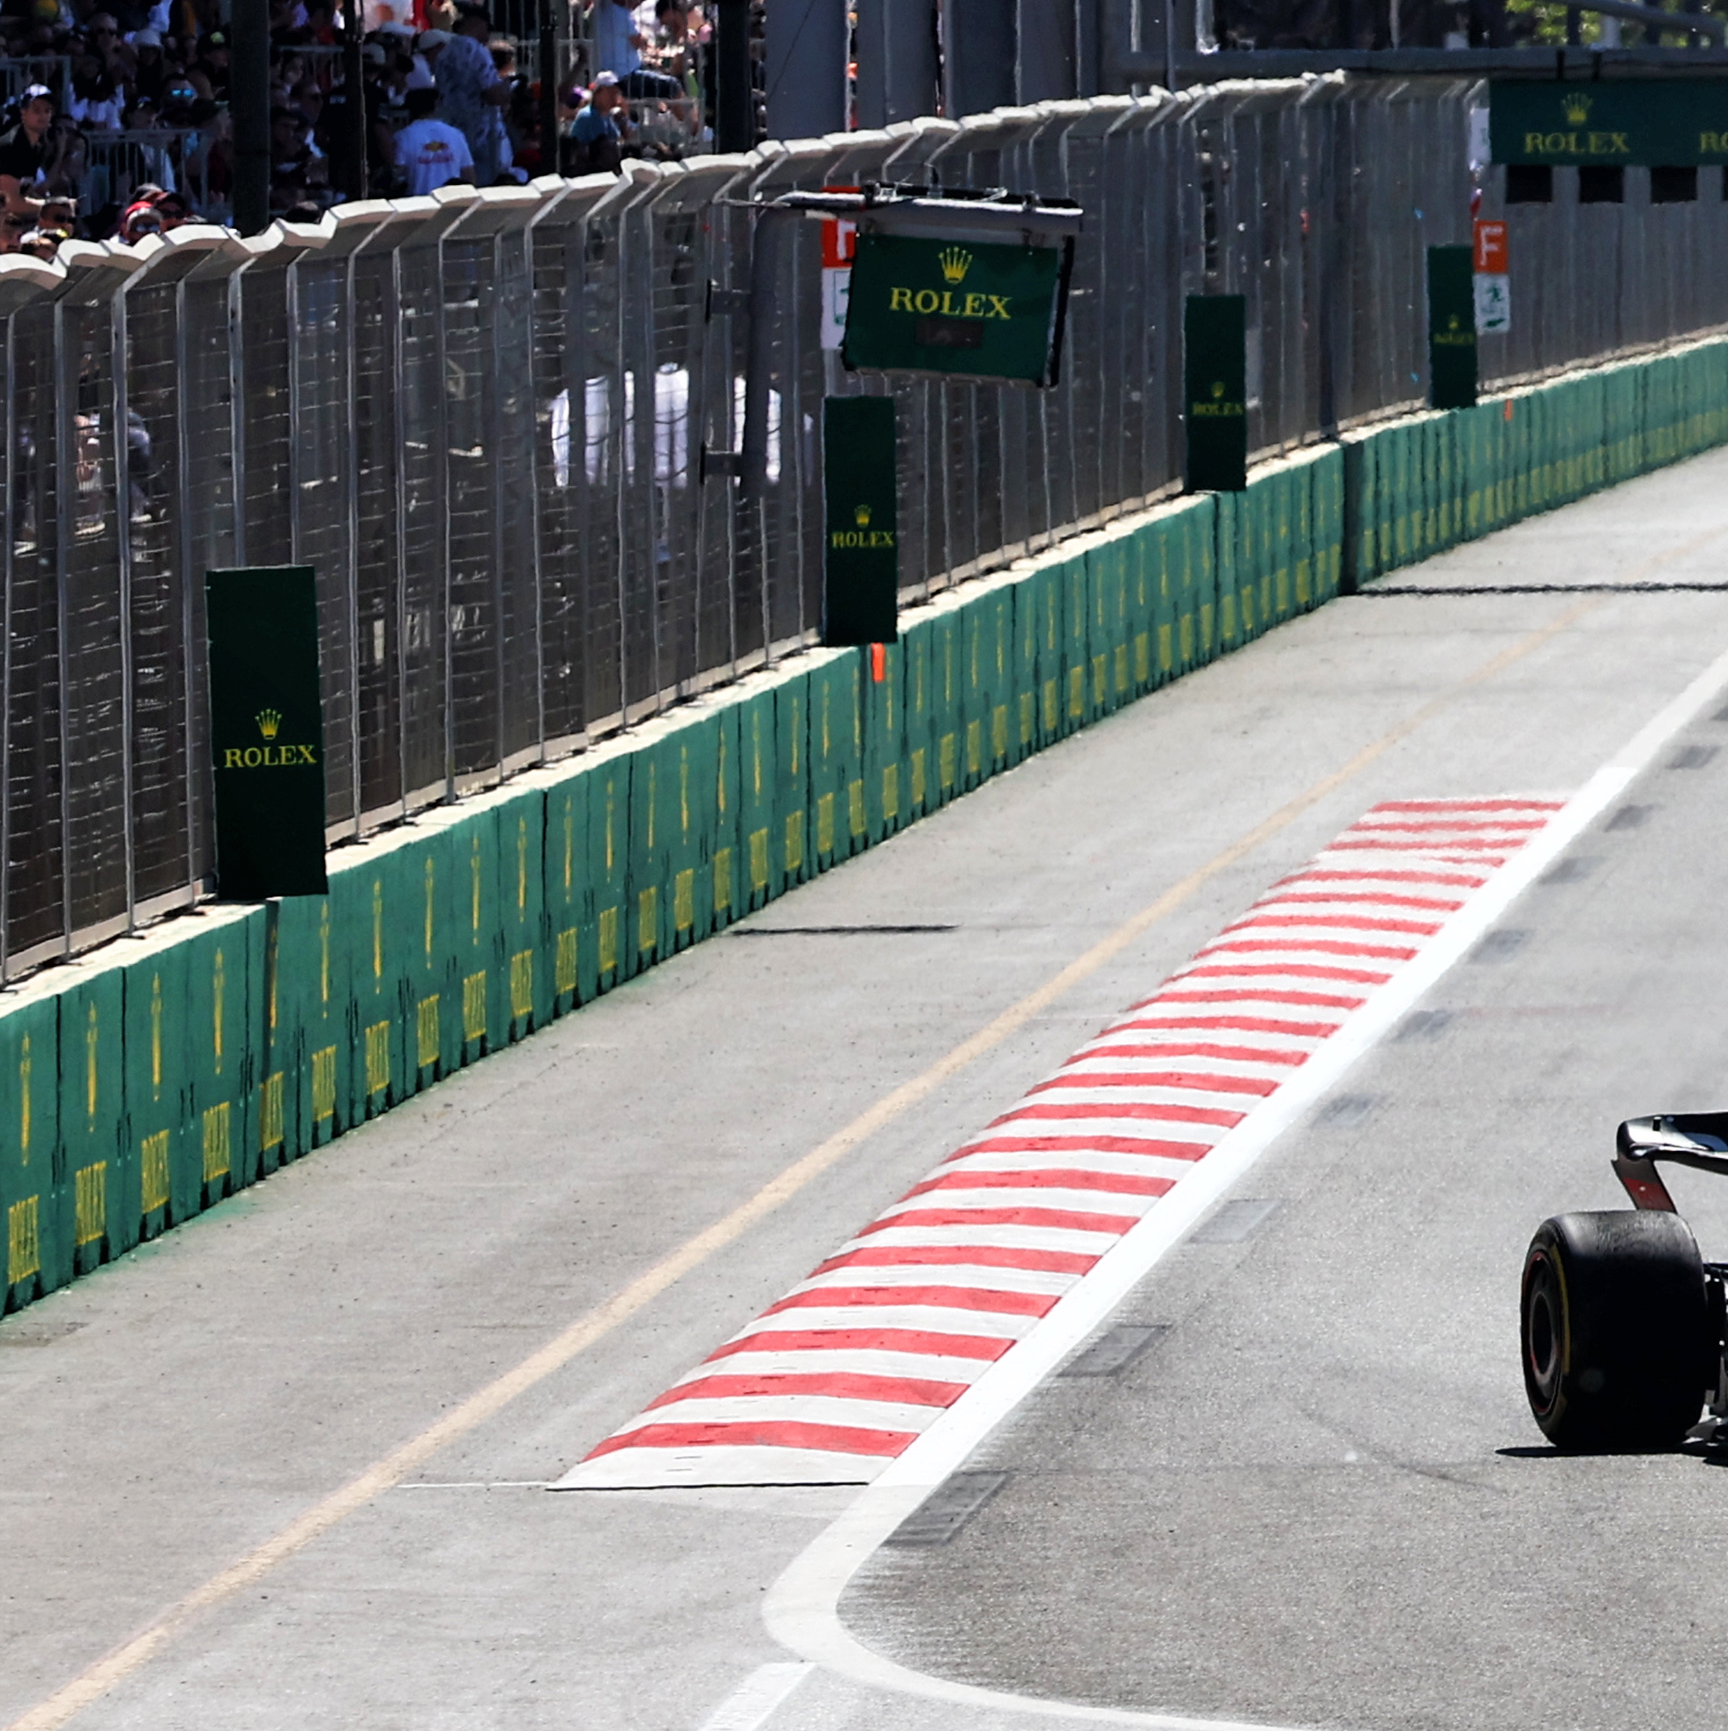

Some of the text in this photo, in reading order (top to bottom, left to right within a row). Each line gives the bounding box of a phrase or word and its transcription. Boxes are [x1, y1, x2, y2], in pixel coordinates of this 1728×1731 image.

[1524, 131, 1630, 155] ROLEX
[1480, 225, 1504, 266] F
[889, 286, 1013, 320] ROLEX
[831, 531, 895, 548] ROLEX
[223, 743, 318, 769] ROLEX
